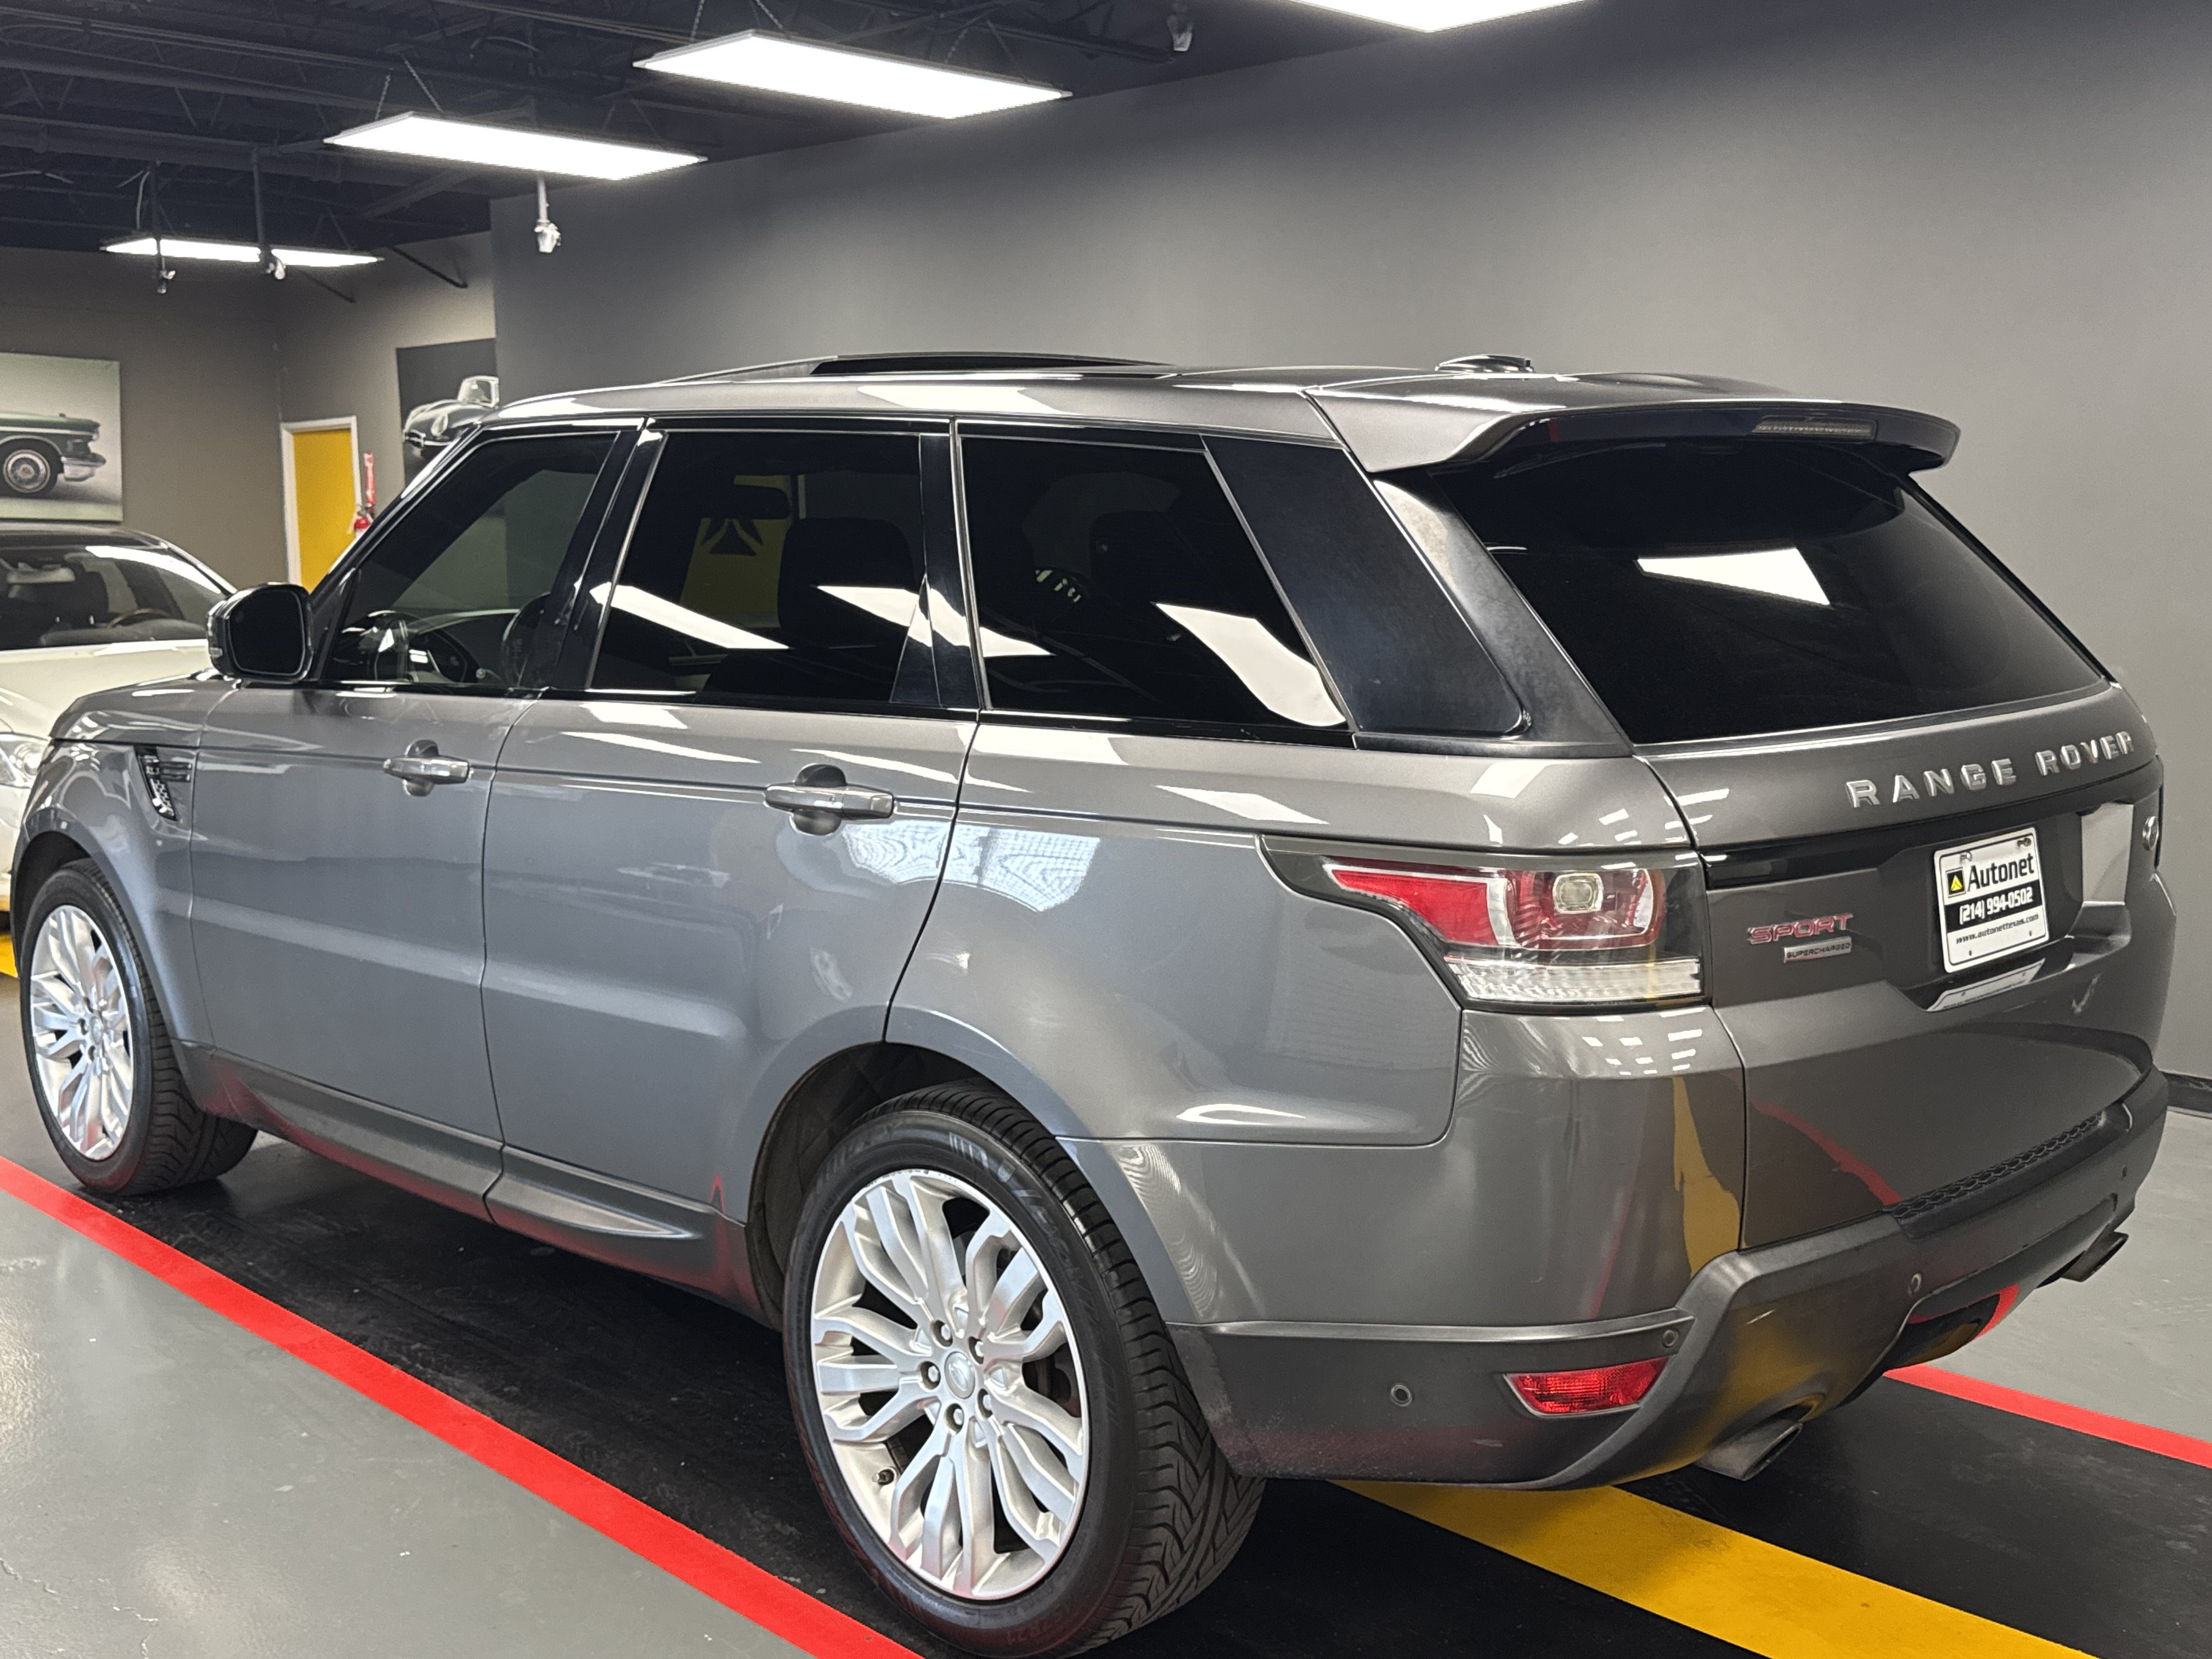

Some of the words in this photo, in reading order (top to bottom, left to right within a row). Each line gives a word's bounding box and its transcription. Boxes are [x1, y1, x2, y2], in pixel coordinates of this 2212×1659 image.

[1846, 758, 2016, 808] RANGE
[2035, 731, 2134, 776] ROVER
[1967, 852, 2035, 892] Autonet
[1959, 900, 1985, 926] (214)
[1986, 886, 2034, 916] 994-0502
[1747, 912, 1853, 945] SPORT
[1786, 942, 1850, 959] SUPERCHARGED
